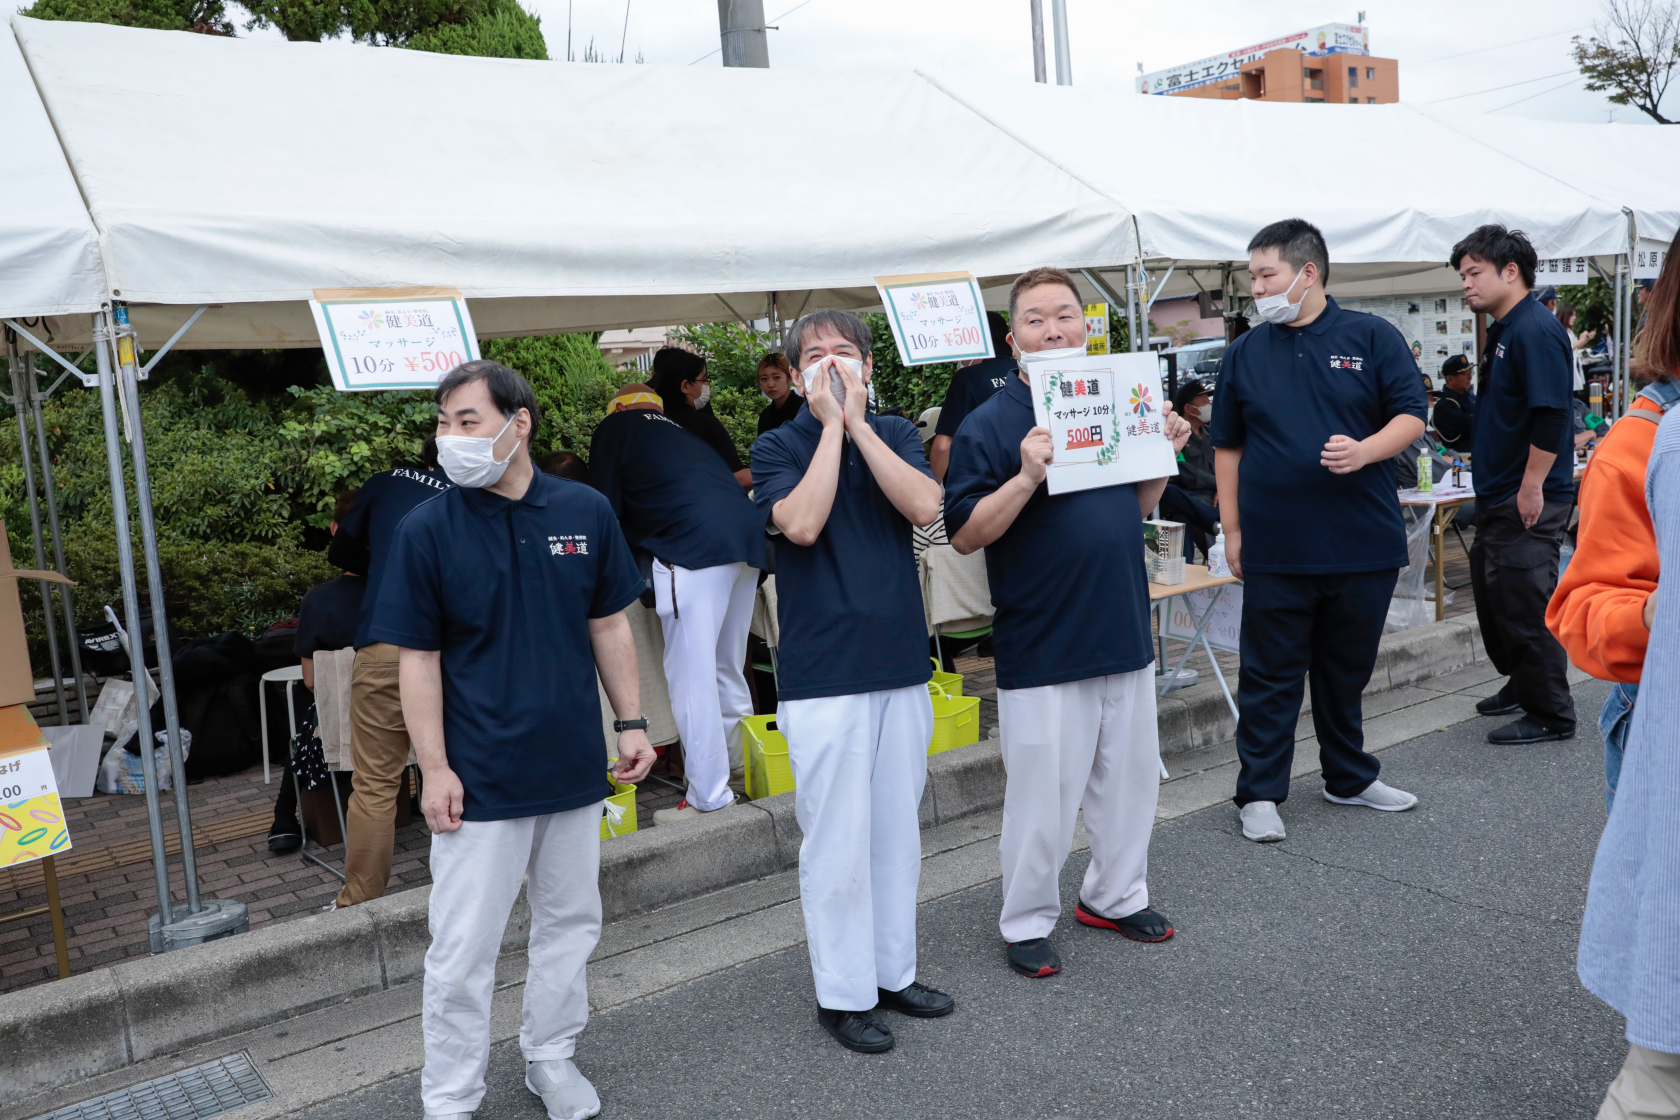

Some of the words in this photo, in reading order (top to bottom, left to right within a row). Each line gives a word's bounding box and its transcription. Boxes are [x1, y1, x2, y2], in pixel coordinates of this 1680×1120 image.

[927, 294, 960, 309] 健美道
[385, 313, 434, 329] 健美道
[919, 314, 962, 327] マッサージ
[368, 337, 436, 349] マッサージ
[909, 333, 939, 350] 10分
[942, 326, 980, 347] ¥500
[350, 355, 396, 375] 10分
[403, 350, 463, 372] ¥500
[1329, 359, 1363, 371] 健美道
[990, 376, 1007, 388] FA
[1059, 378, 1100, 398] 健美道
[1053, 405, 1091, 420] マッサージ
[1092, 404, 1110, 416] 10分
[1067, 424, 1103, 443] 500円
[1126, 418, 1161, 437] 健美道
[549, 541, 589, 556] 健美道
[0, 784, 22, 799] 00
